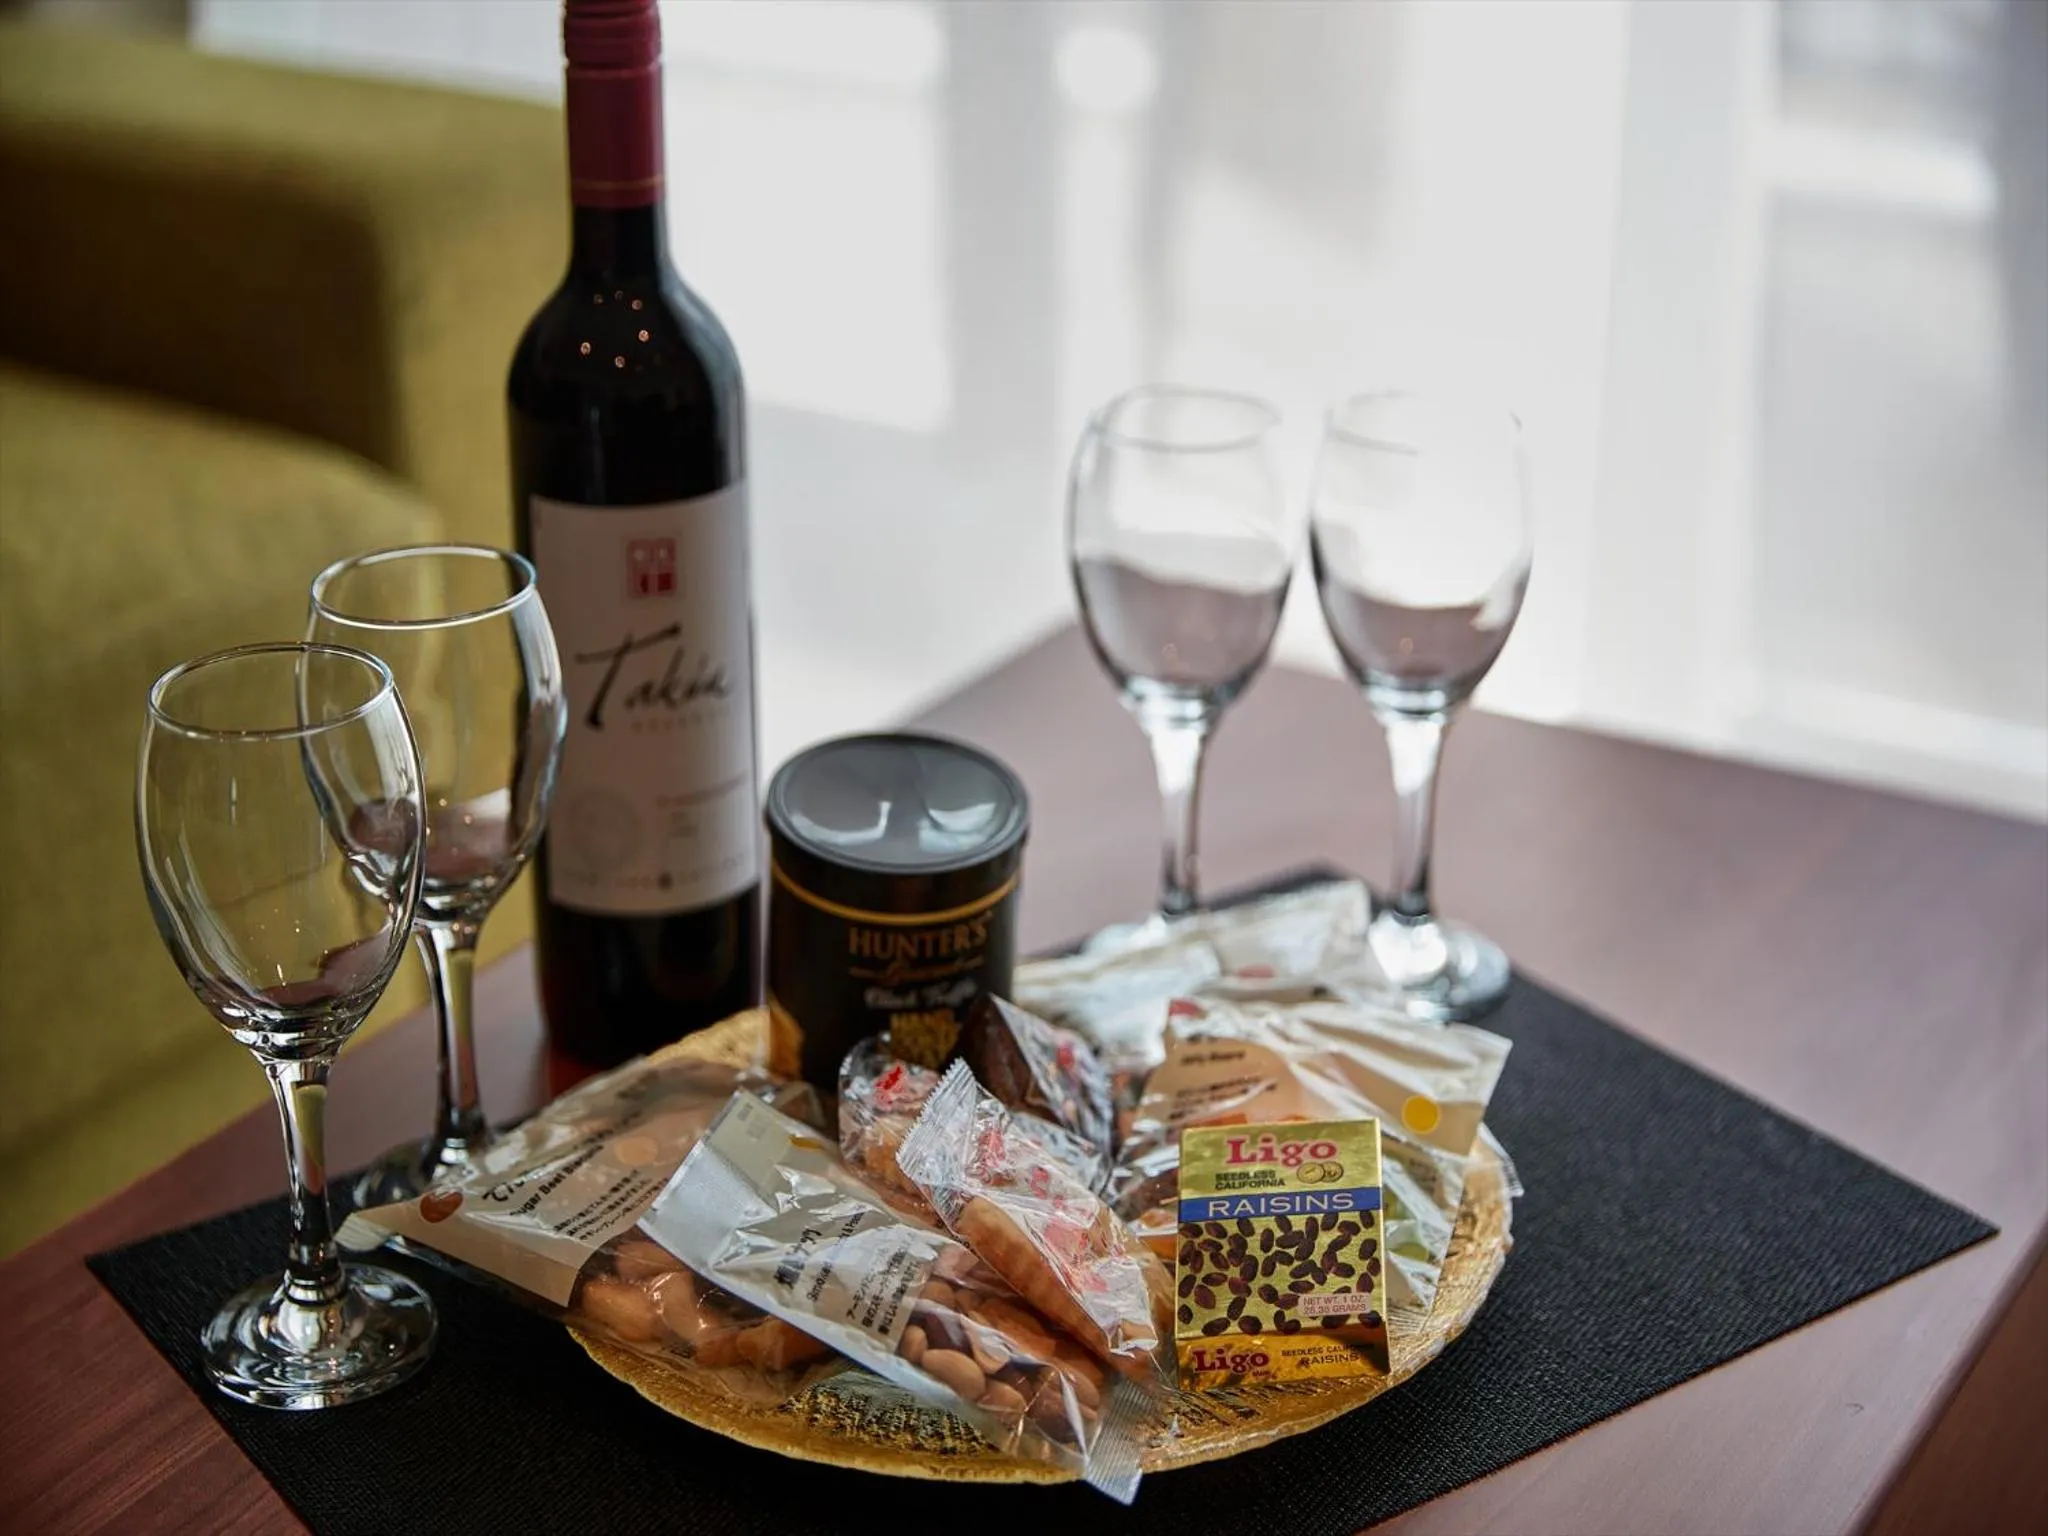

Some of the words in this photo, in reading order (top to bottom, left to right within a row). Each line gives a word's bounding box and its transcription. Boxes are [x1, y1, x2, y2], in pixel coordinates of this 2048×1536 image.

[1226, 1136, 1337, 1167] Ligo
[1214, 1169, 1277, 1182] SEEDLESS
[1214, 1178, 1286, 1191] CALIFORNIA
[1208, 1192, 1355, 1218] RAISINS
[1303, 1296, 1321, 1306] NET
[1331, 1303, 1367, 1313] GRAMS
[1193, 1347, 1270, 1374] Ligo
[1298, 1351, 1361, 1369] RAISINS
